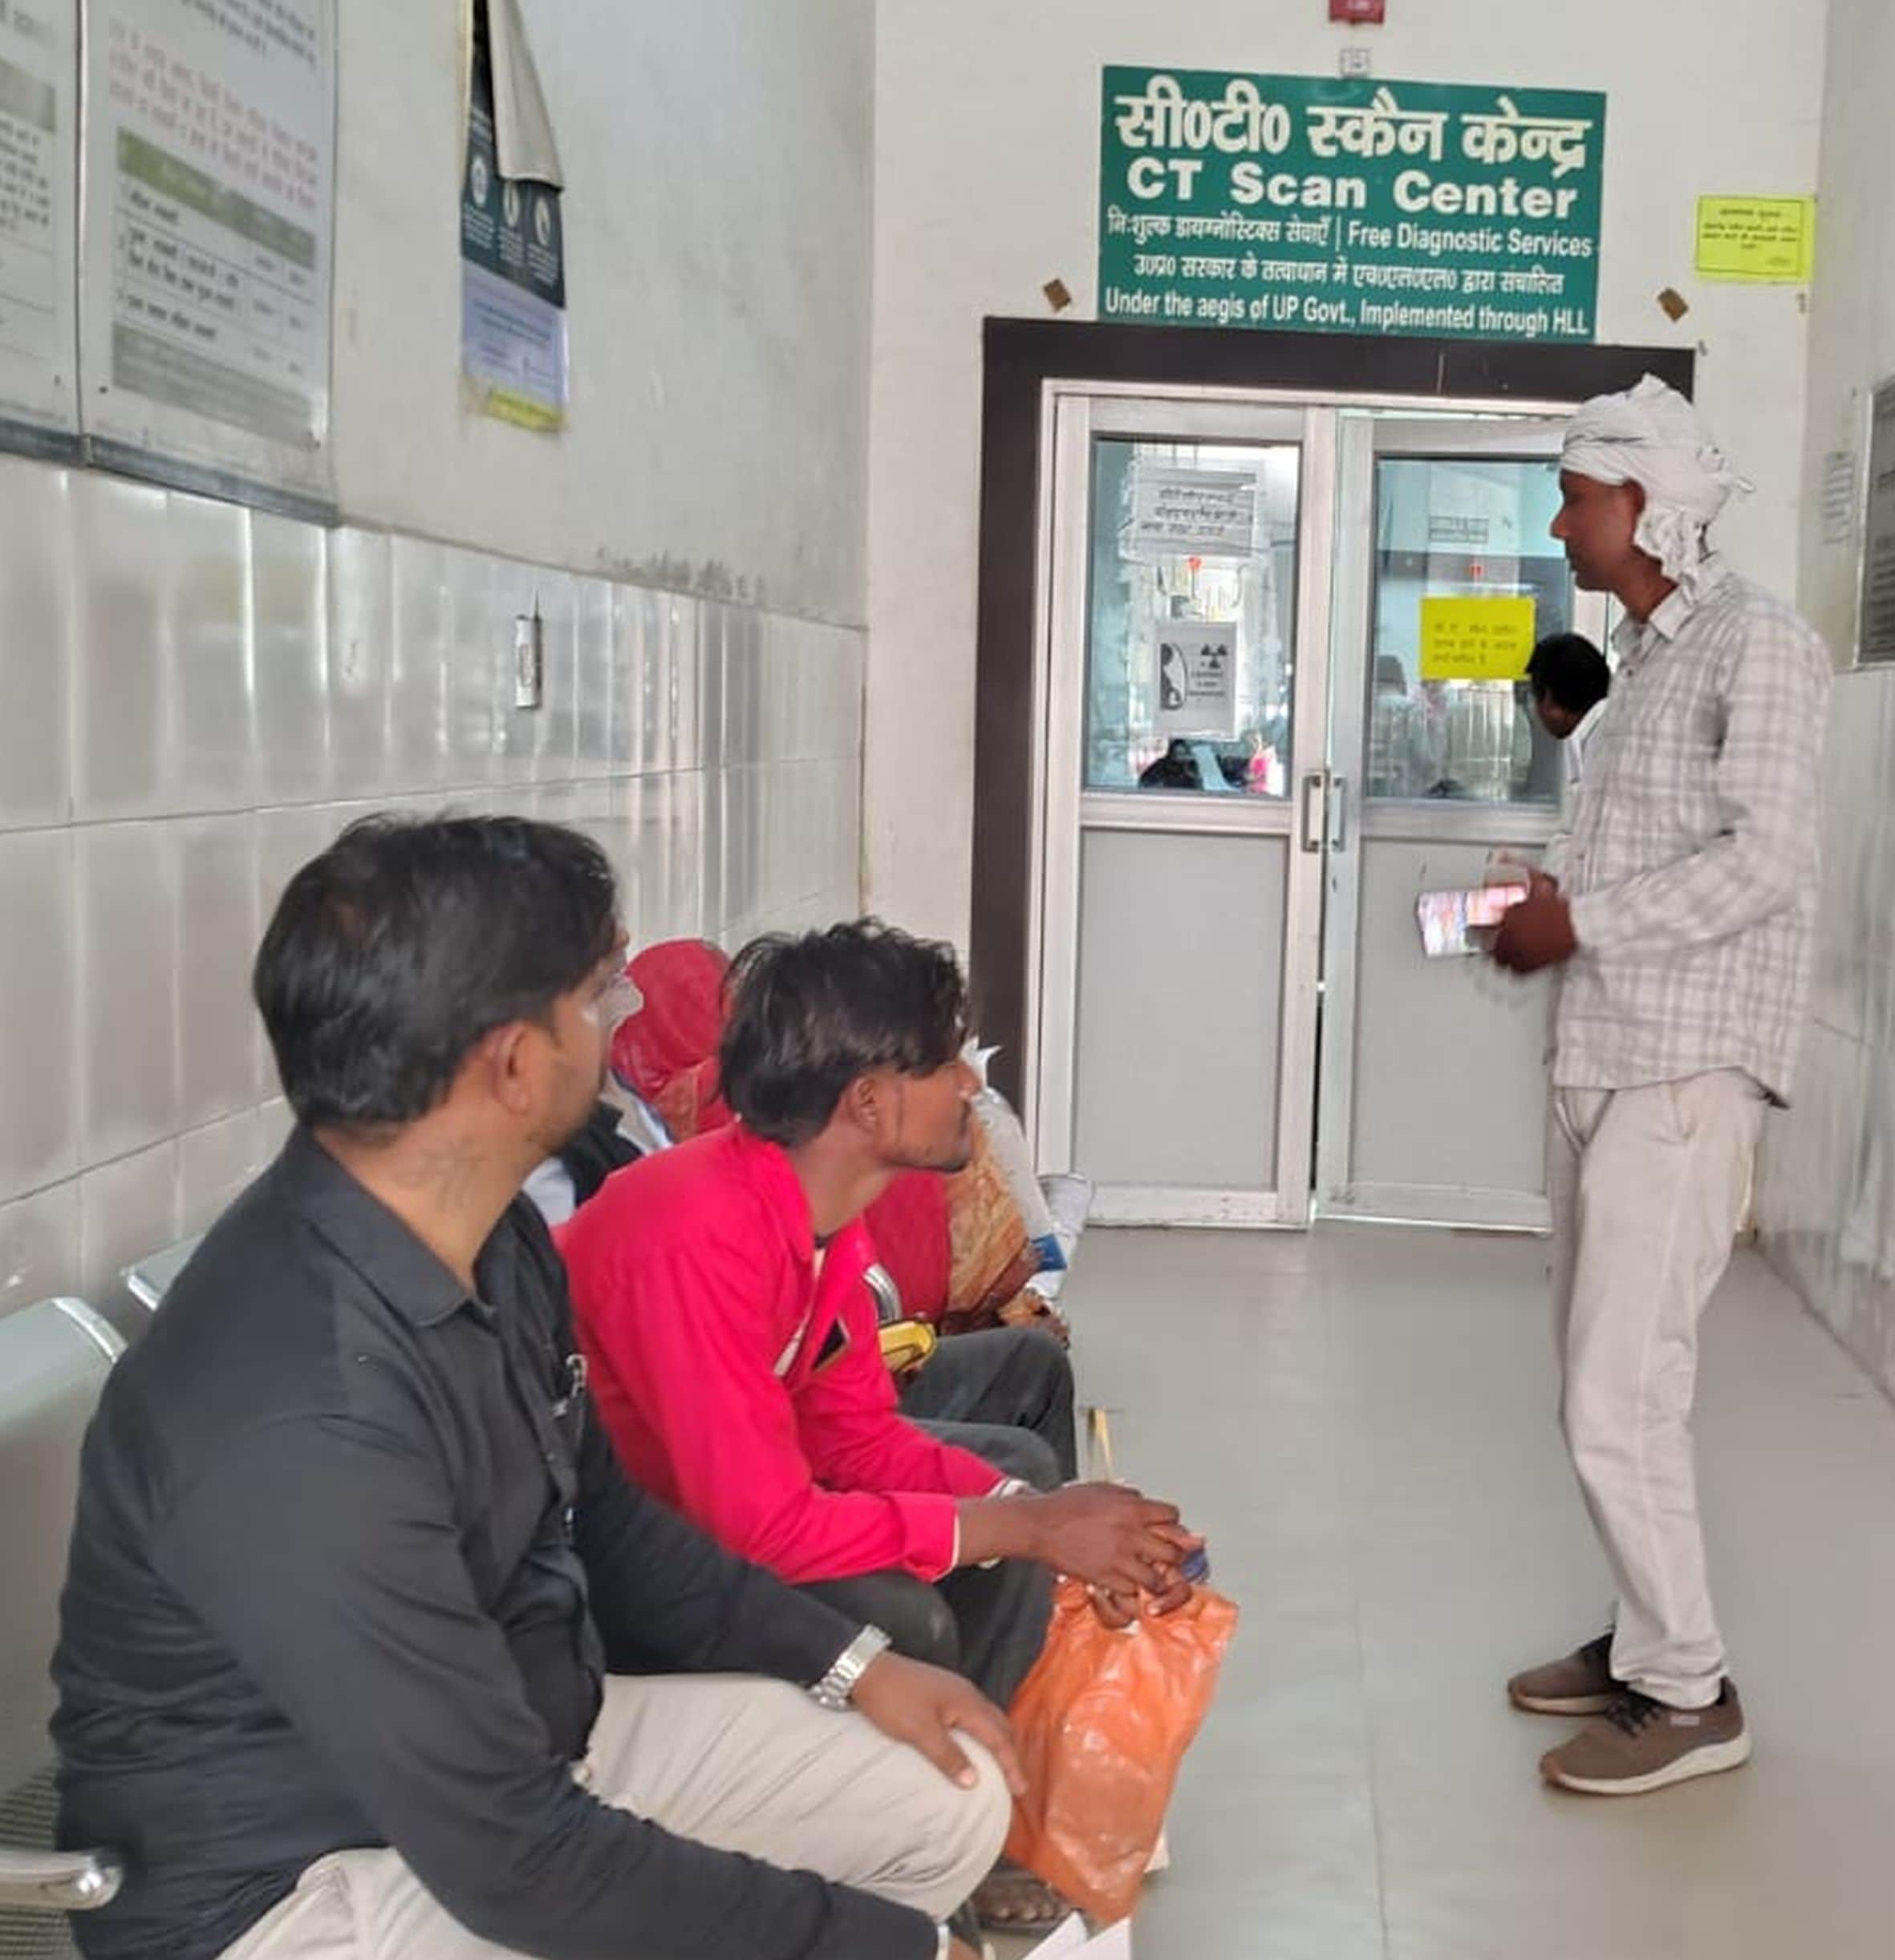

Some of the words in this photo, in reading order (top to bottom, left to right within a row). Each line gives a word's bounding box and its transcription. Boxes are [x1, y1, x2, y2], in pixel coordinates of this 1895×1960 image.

[1306, 87, 1448, 160] स्कैन
[1460, 95, 1593, 179] केन्द्र
[1126, 156, 1203, 200] CT
[1229, 161, 1366, 209] Scan
[1393, 169, 1577, 218] Center
[1348, 221, 1391, 248] Free
[1397, 222, 1503, 257] Diagnostic
[1507, 228, 1593, 257] Services
[1181, 257, 1237, 279] सरकार
[1240, 250, 1258, 278] के
[1333, 256, 1348, 284] में
[1106, 286, 1160, 314] Under
[1164, 290, 1193, 316] the
[1197, 292, 1244, 324] aegis
[1250, 294, 1269, 319] of
[1273, 295, 1299, 320] UP
[1360, 298, 1475, 331] Implemented
[1479, 303, 1548, 338] through
[1552, 307, 1589, 335] HLL
